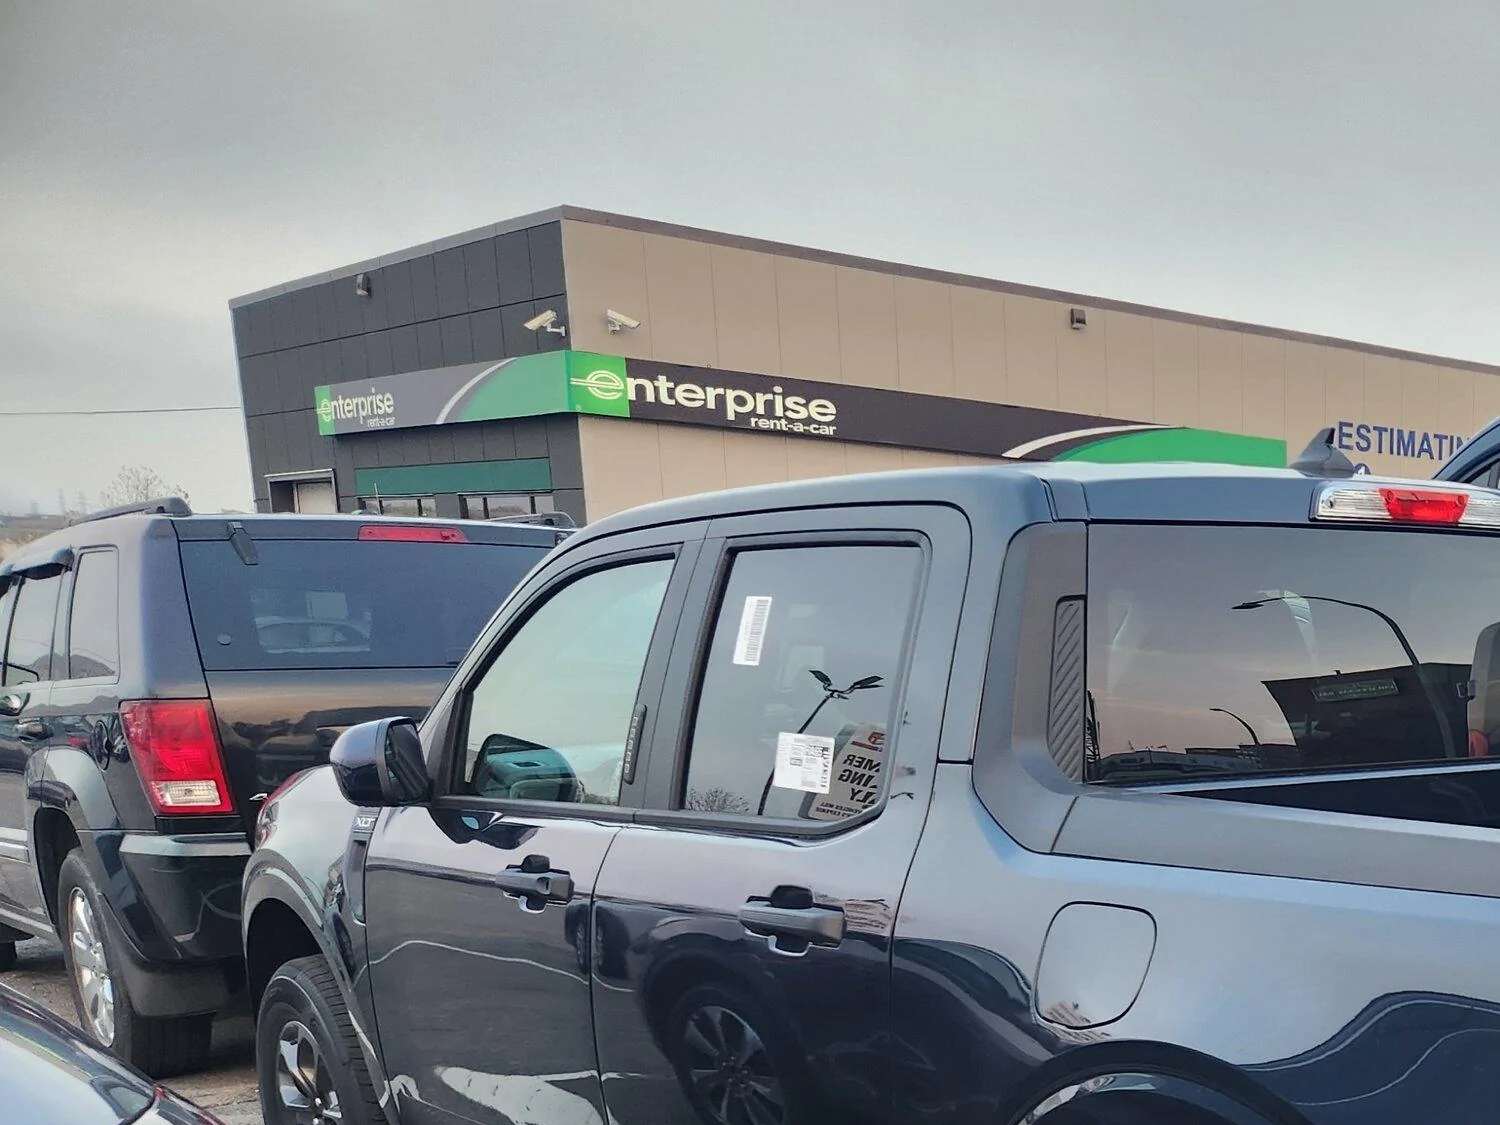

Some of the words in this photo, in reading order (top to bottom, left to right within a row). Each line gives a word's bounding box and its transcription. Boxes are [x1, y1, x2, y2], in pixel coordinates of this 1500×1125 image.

[315, 387, 394, 424] enterprise
[571, 369, 837, 421] enterprise
[750, 416, 837, 436] rent-a-car
